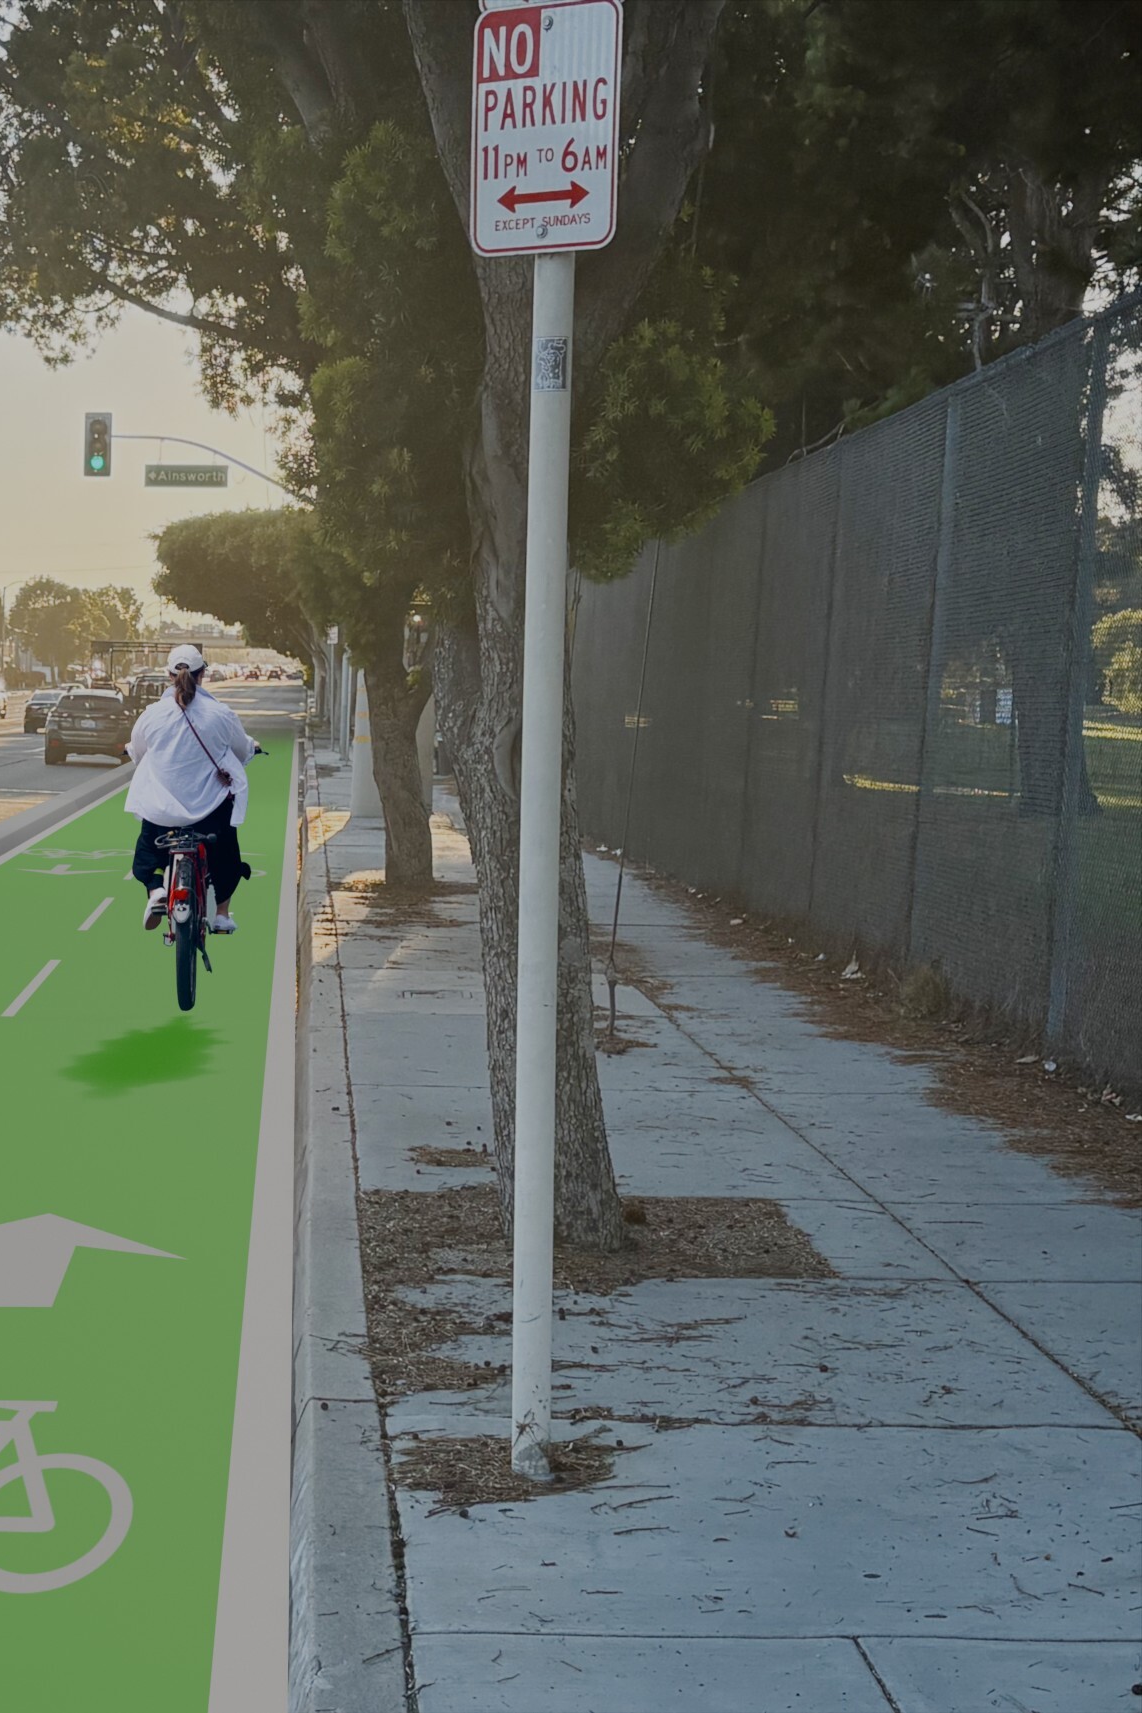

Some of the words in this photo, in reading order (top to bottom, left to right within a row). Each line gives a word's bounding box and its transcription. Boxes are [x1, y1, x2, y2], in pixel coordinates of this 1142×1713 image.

[482, 23, 534, 78] NO
[483, 77, 608, 132] PARKING
[482, 144, 528, 180] 11PM
[536, 147, 554, 163] TO
[561, 137, 608, 173] 6AM
[495, 217, 535, 232] EXCEPT
[542, 213, 591, 228] SUNDAYS
[158, 470, 226, 482] Ainsworth
